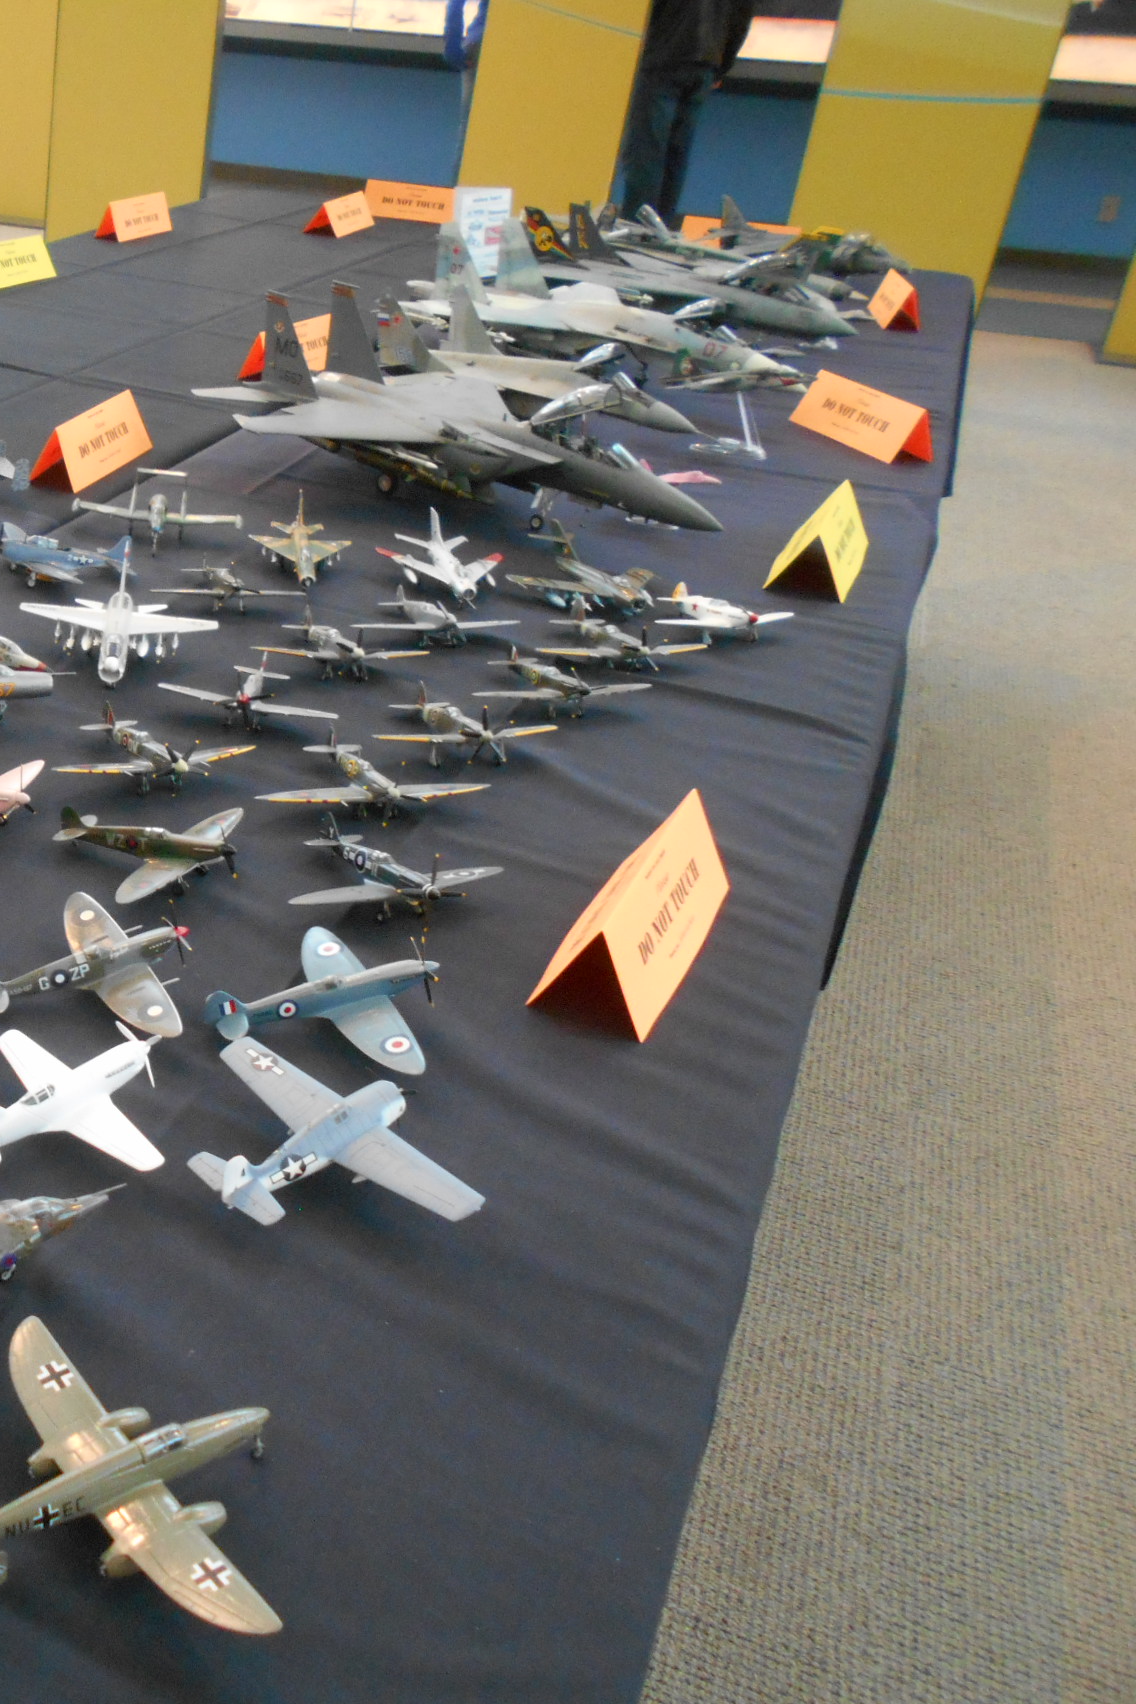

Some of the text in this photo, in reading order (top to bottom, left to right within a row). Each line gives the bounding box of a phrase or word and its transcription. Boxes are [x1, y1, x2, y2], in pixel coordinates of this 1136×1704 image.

[382, 196, 445, 210] DO NOT TOUCH
[0, 257, 14, 268] NOT
[14, 253, 37, 265] TOUCH
[822, 397, 836, 411] DO
[837, 403, 857, 419] NOT
[856, 411, 891, 433] TOUCH
[78, 442, 91, 459] DO
[90, 434, 106, 452] NOT
[104, 421, 129, 444] TOUCH
[638, 932, 655, 966] DO
[651, 901, 674, 938] NOT
[670, 858, 700, 912] TOUCH
[68, 963, 91, 982] ZP
[38, 975, 51, 991] G
